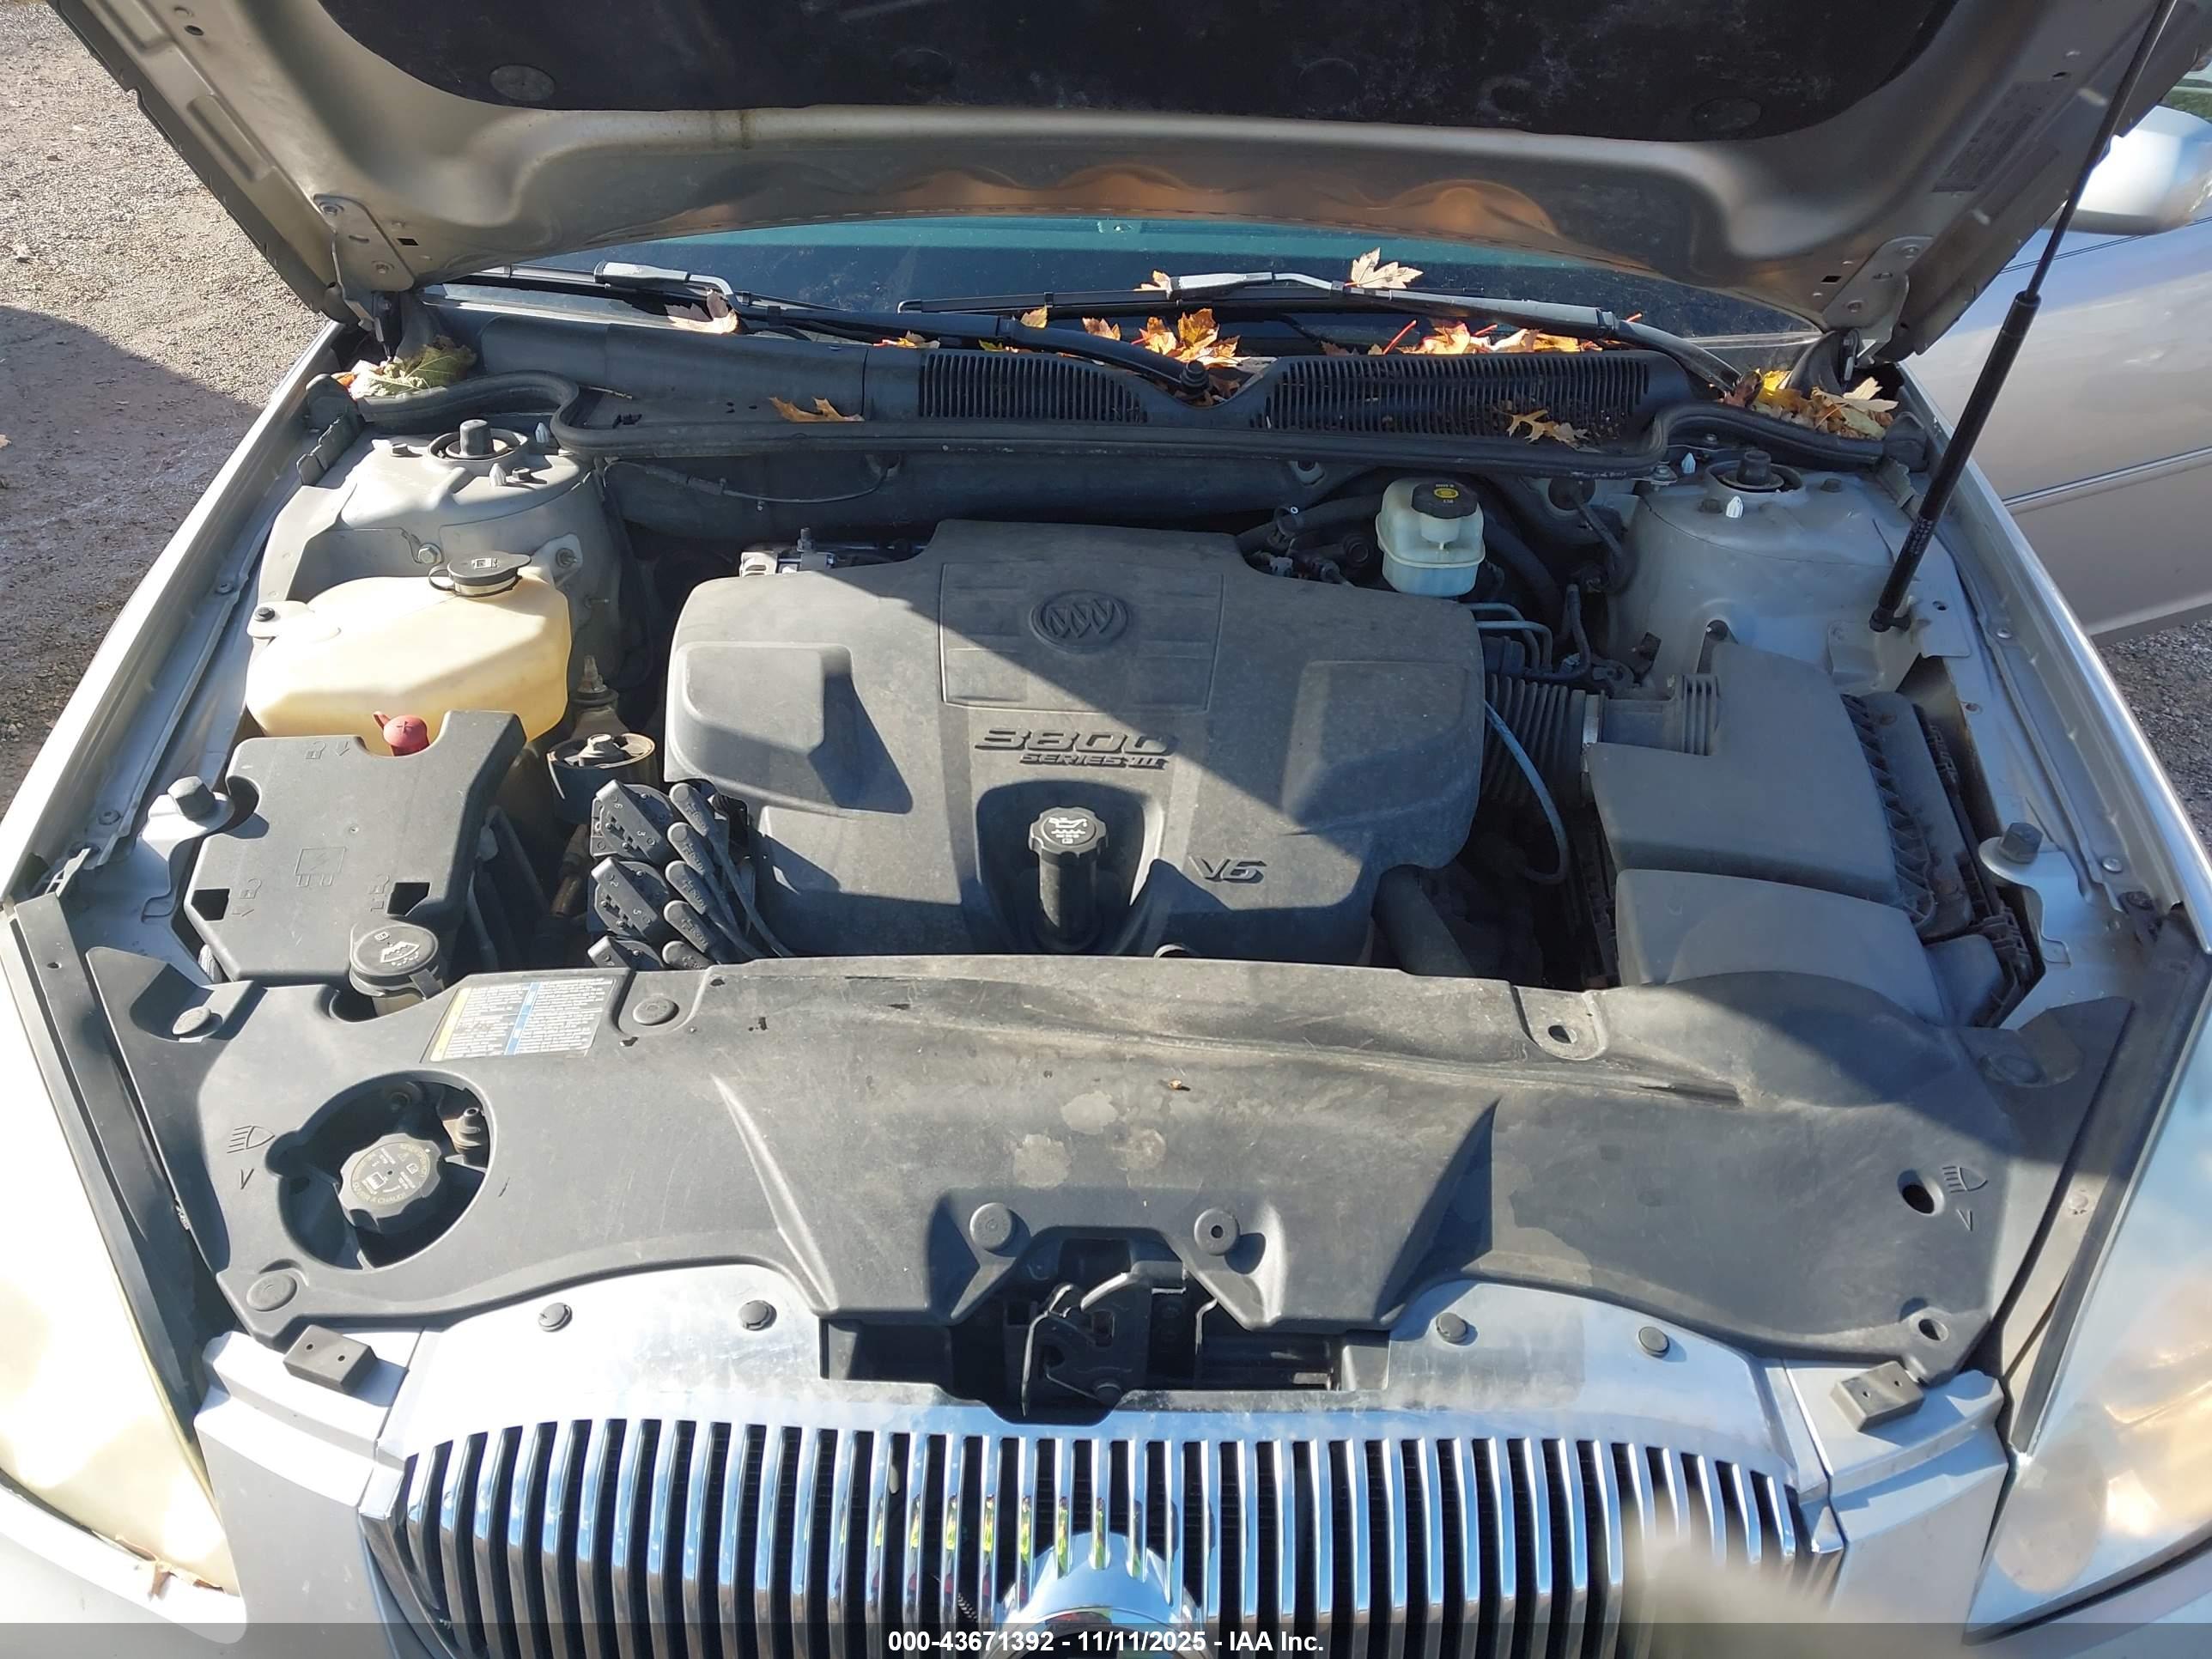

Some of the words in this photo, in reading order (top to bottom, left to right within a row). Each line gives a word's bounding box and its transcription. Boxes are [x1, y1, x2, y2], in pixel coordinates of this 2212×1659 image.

[975, 728, 1174, 756] 3800
[1019, 752, 1127, 769] SERIES
[1188, 856, 1267, 884] V6
